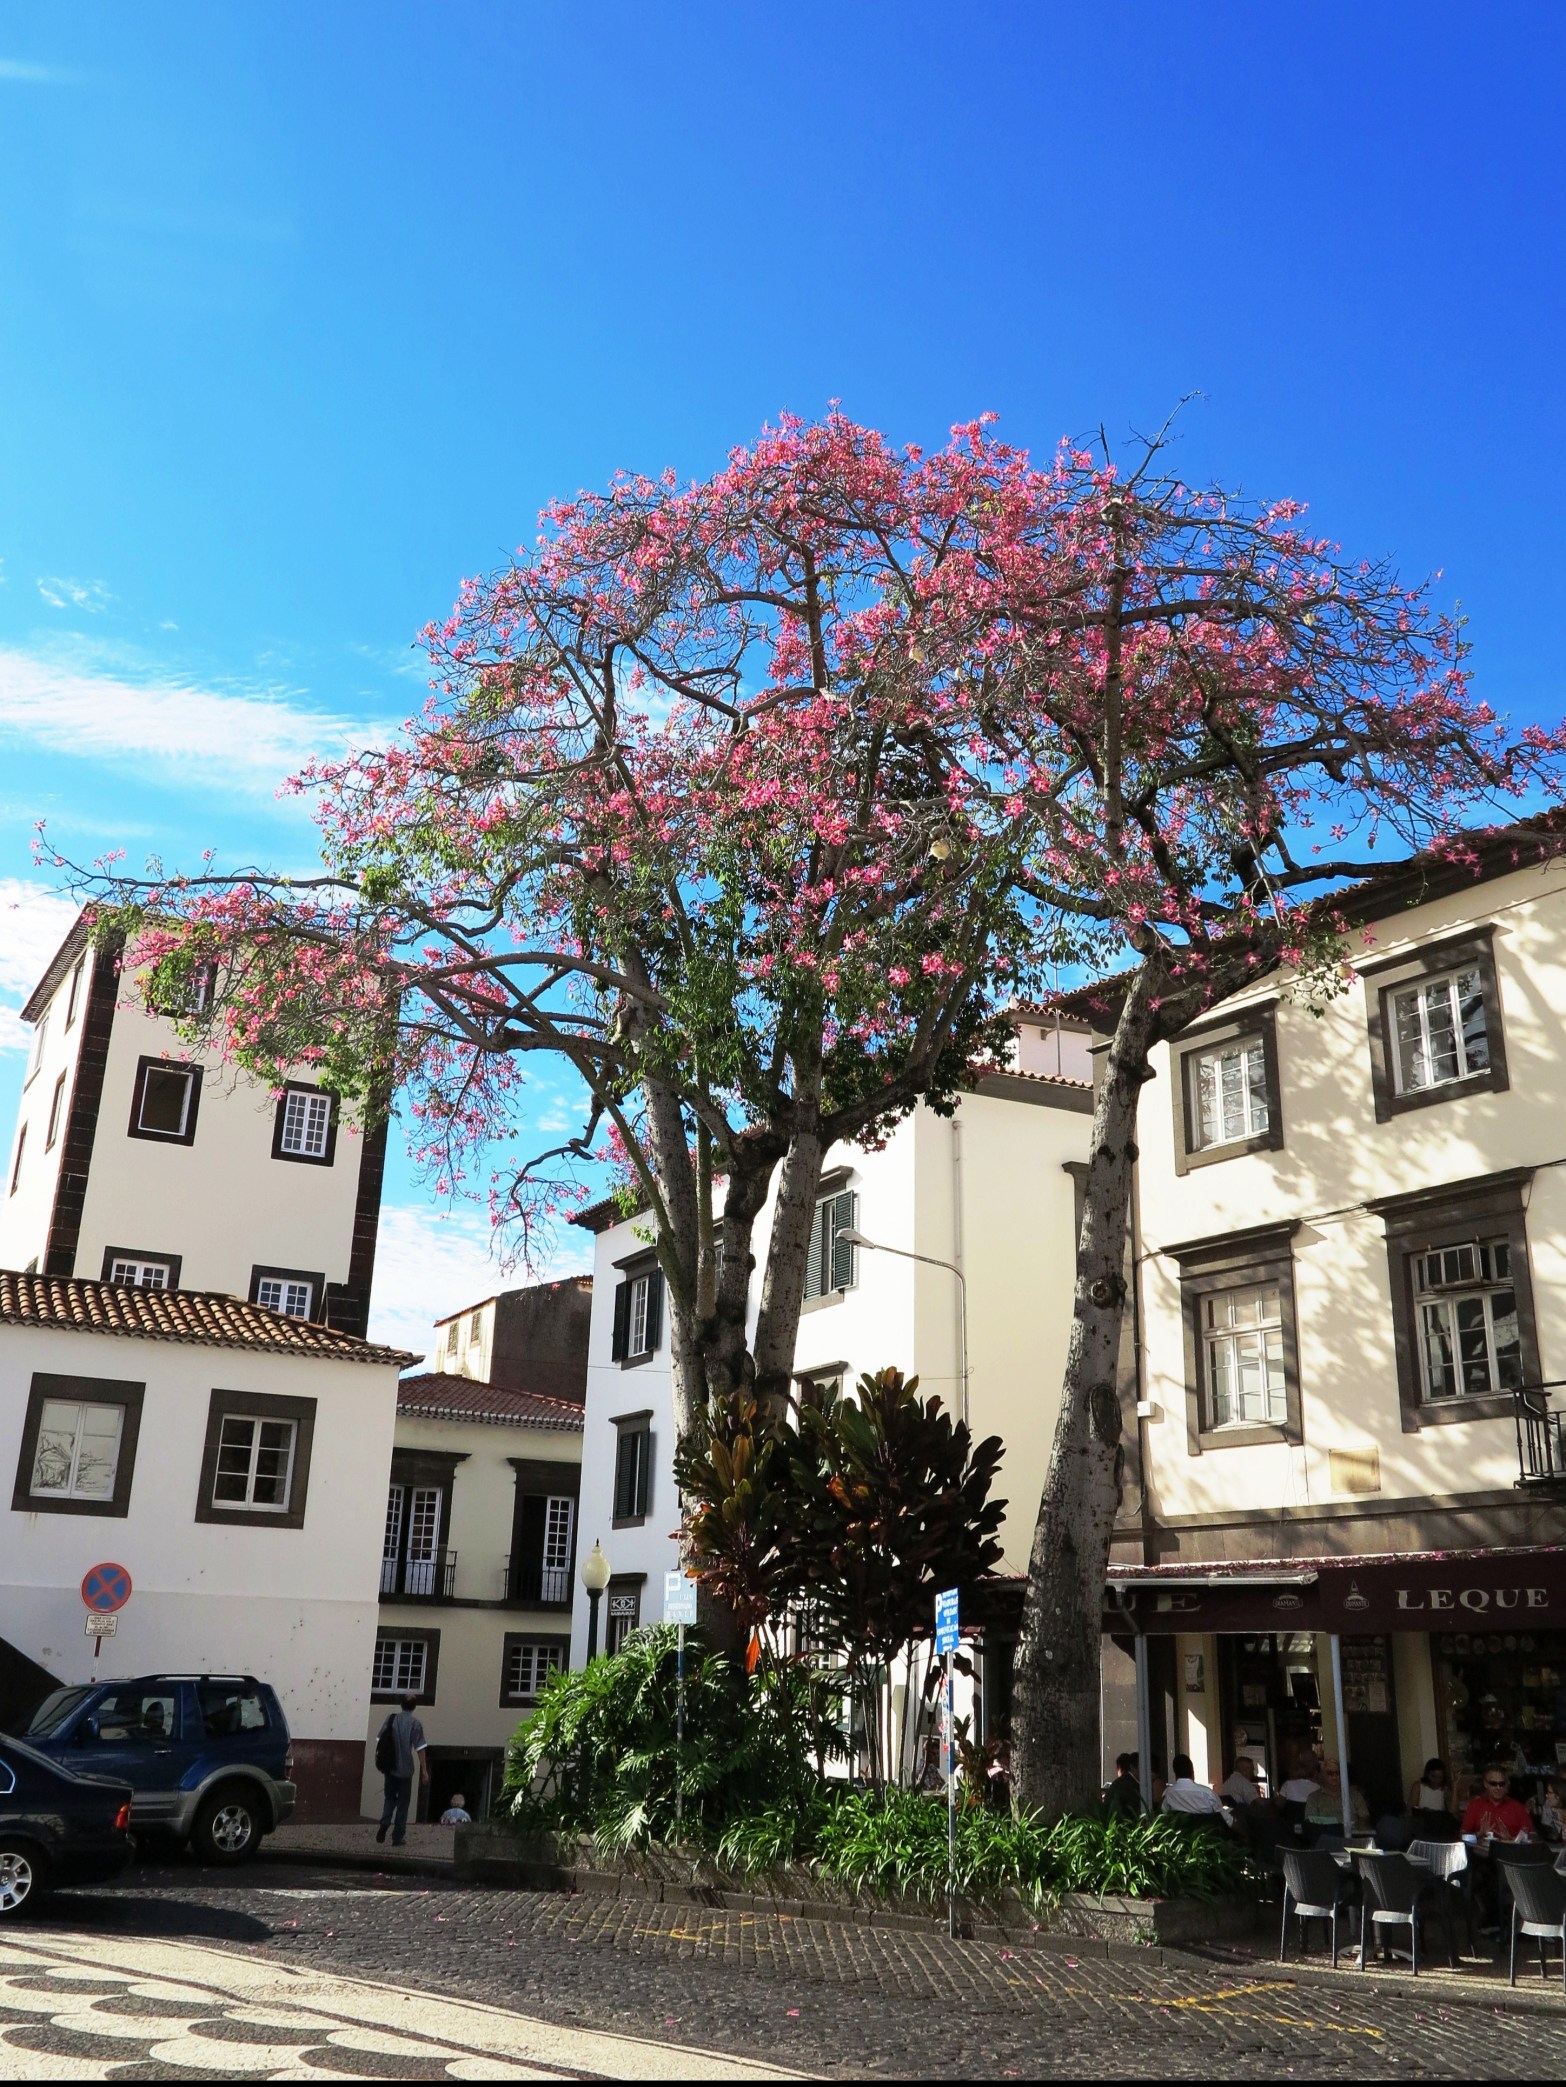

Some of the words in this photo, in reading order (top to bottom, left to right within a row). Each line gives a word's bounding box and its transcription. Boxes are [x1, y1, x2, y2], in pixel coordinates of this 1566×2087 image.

[665, 1573, 682, 1602] P
[1394, 1588, 1549, 1613] LEQUE
[935, 1593, 943, 1624] P
